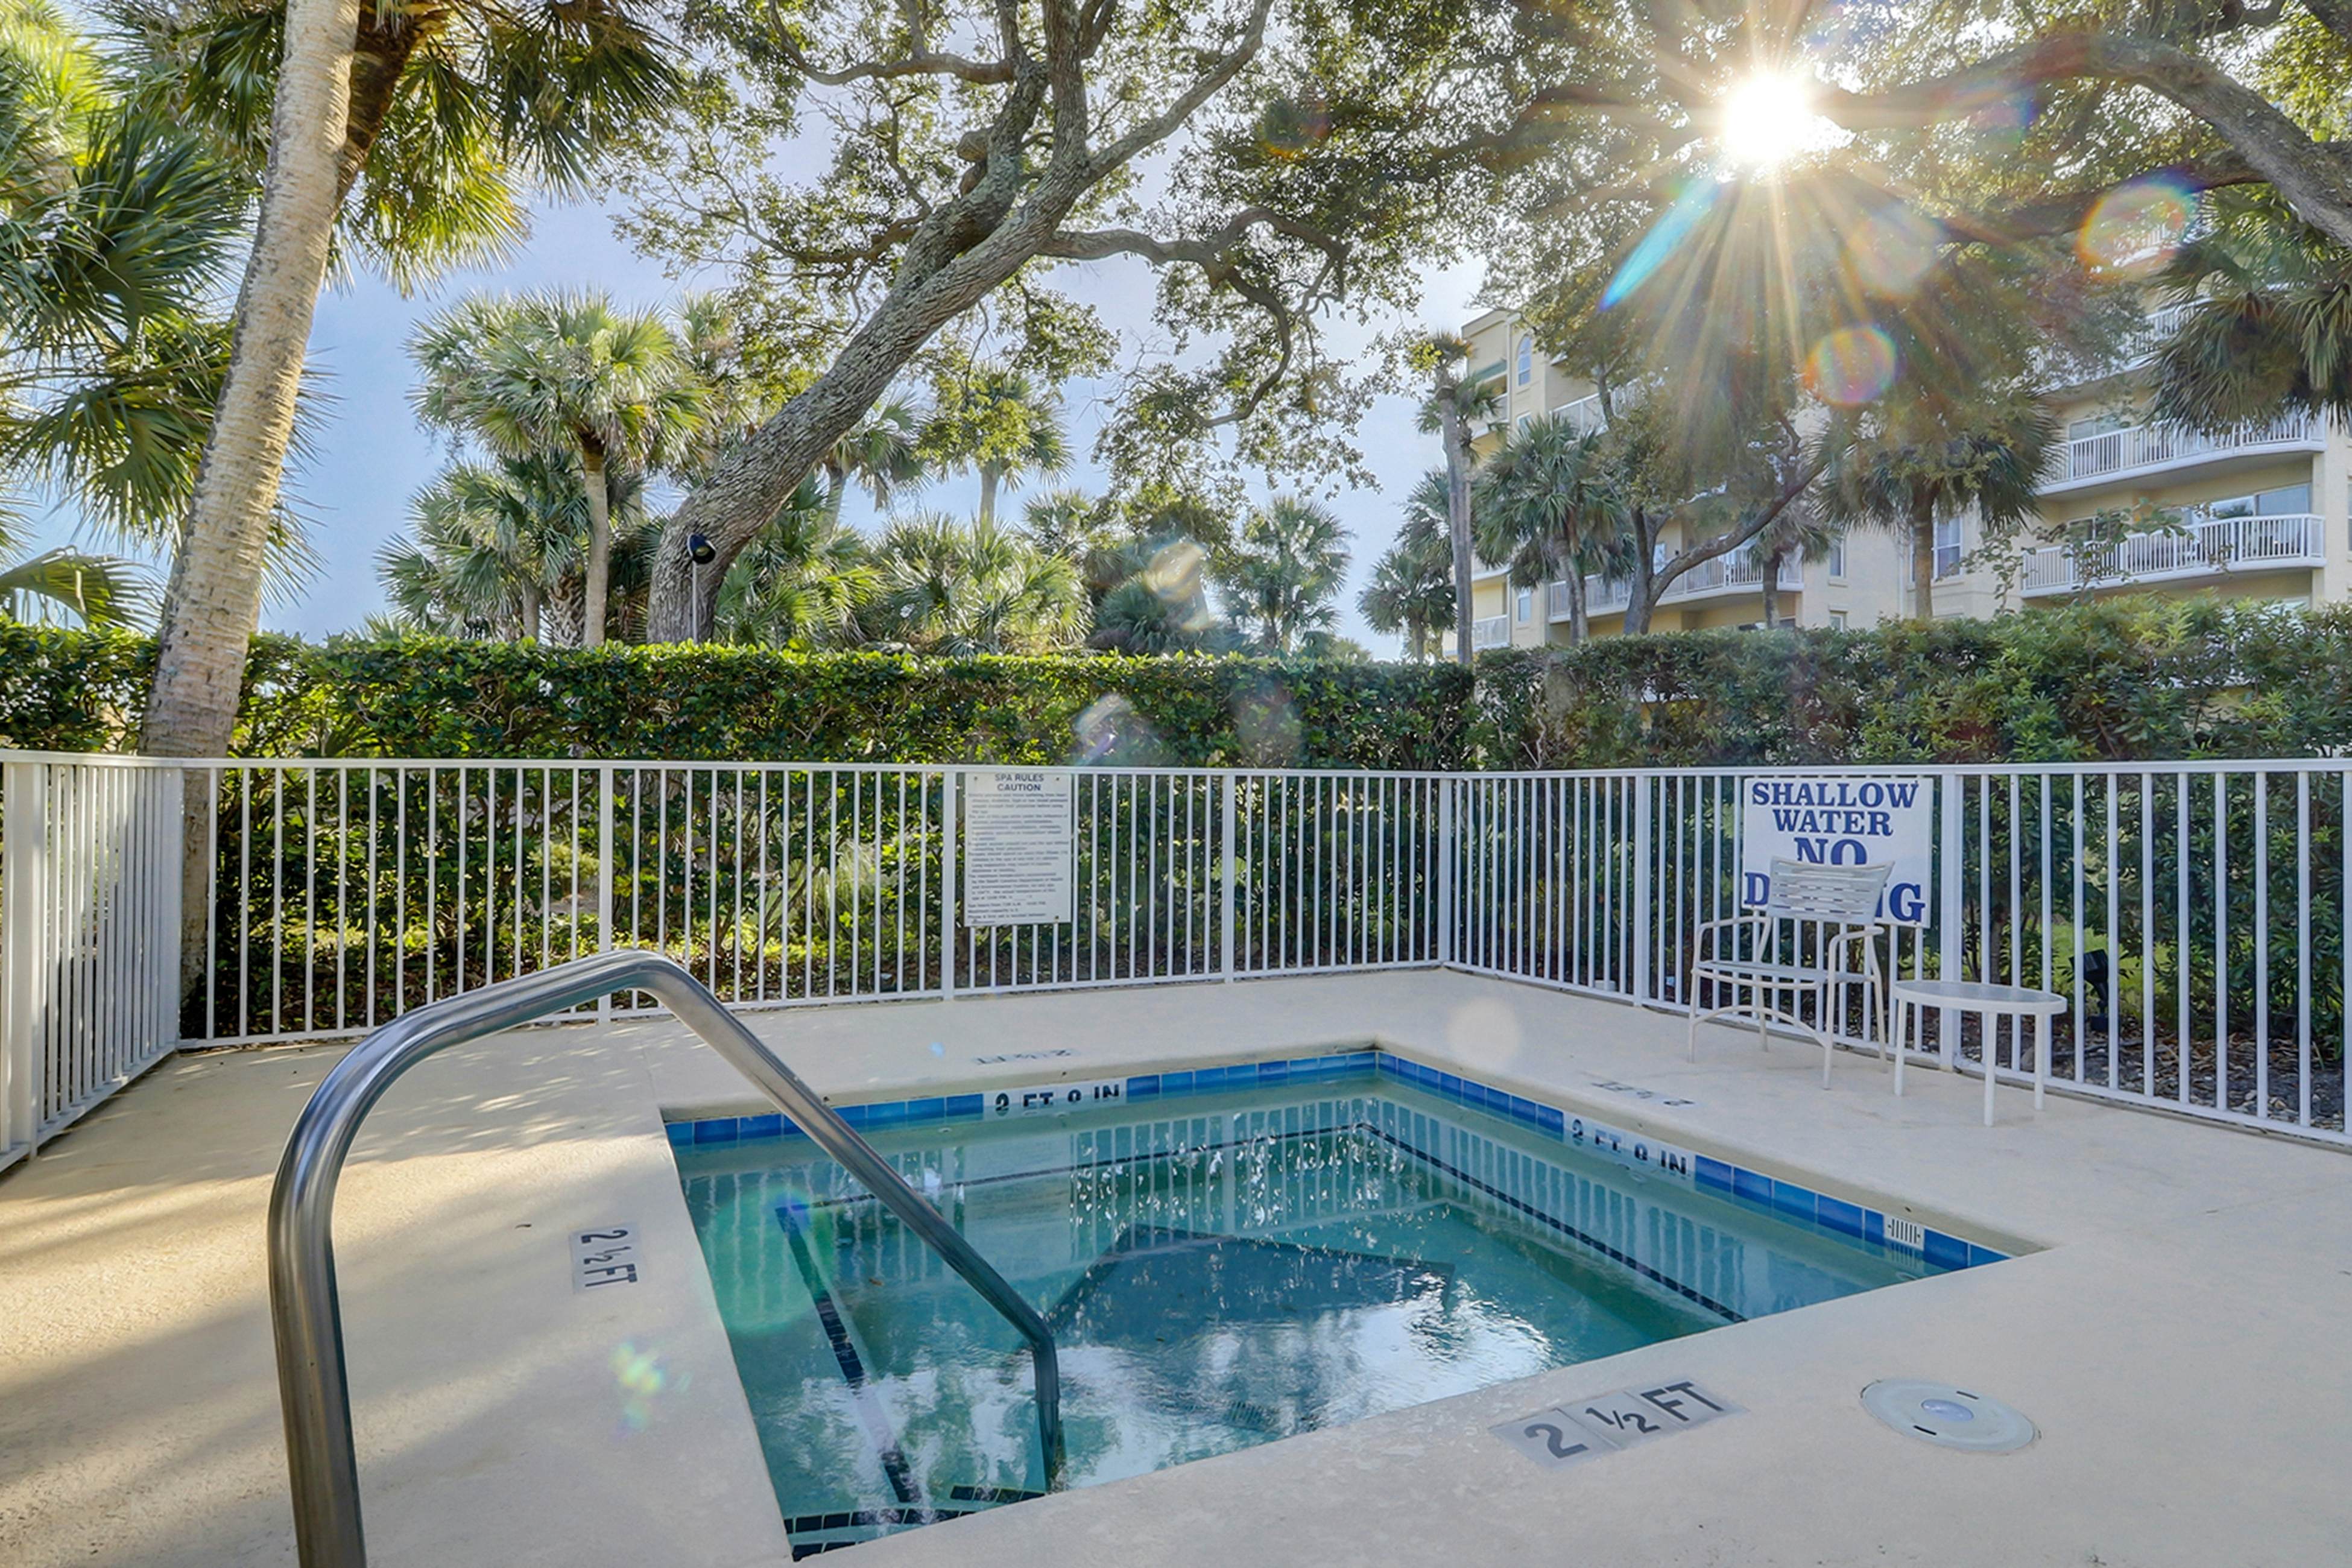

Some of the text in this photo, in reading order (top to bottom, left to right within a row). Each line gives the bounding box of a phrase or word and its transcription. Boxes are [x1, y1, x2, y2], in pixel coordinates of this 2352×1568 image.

[995, 773, 1045, 782] SPA RULES
[997, 783, 1042, 791] CAUTION
[1752, 782, 1919, 808] SHALLOW
[1772, 809, 1893, 836] WATER
[1794, 838, 1867, 865] NO
[995, 1092, 1010, 1111] 2
[1023, 1092, 1054, 1107] FT
[1094, 1084, 1119, 1099] IN
[1572, 1119, 1583, 1142] 2
[1595, 1129, 1622, 1151] FT
[1660, 1150, 1687, 1175] IN
[581, 1229, 628, 1244] 2
[584, 1263, 638, 1288] FT
[1523, 1422, 1589, 1459] 2
[1640, 1380, 1725, 1422] FT
